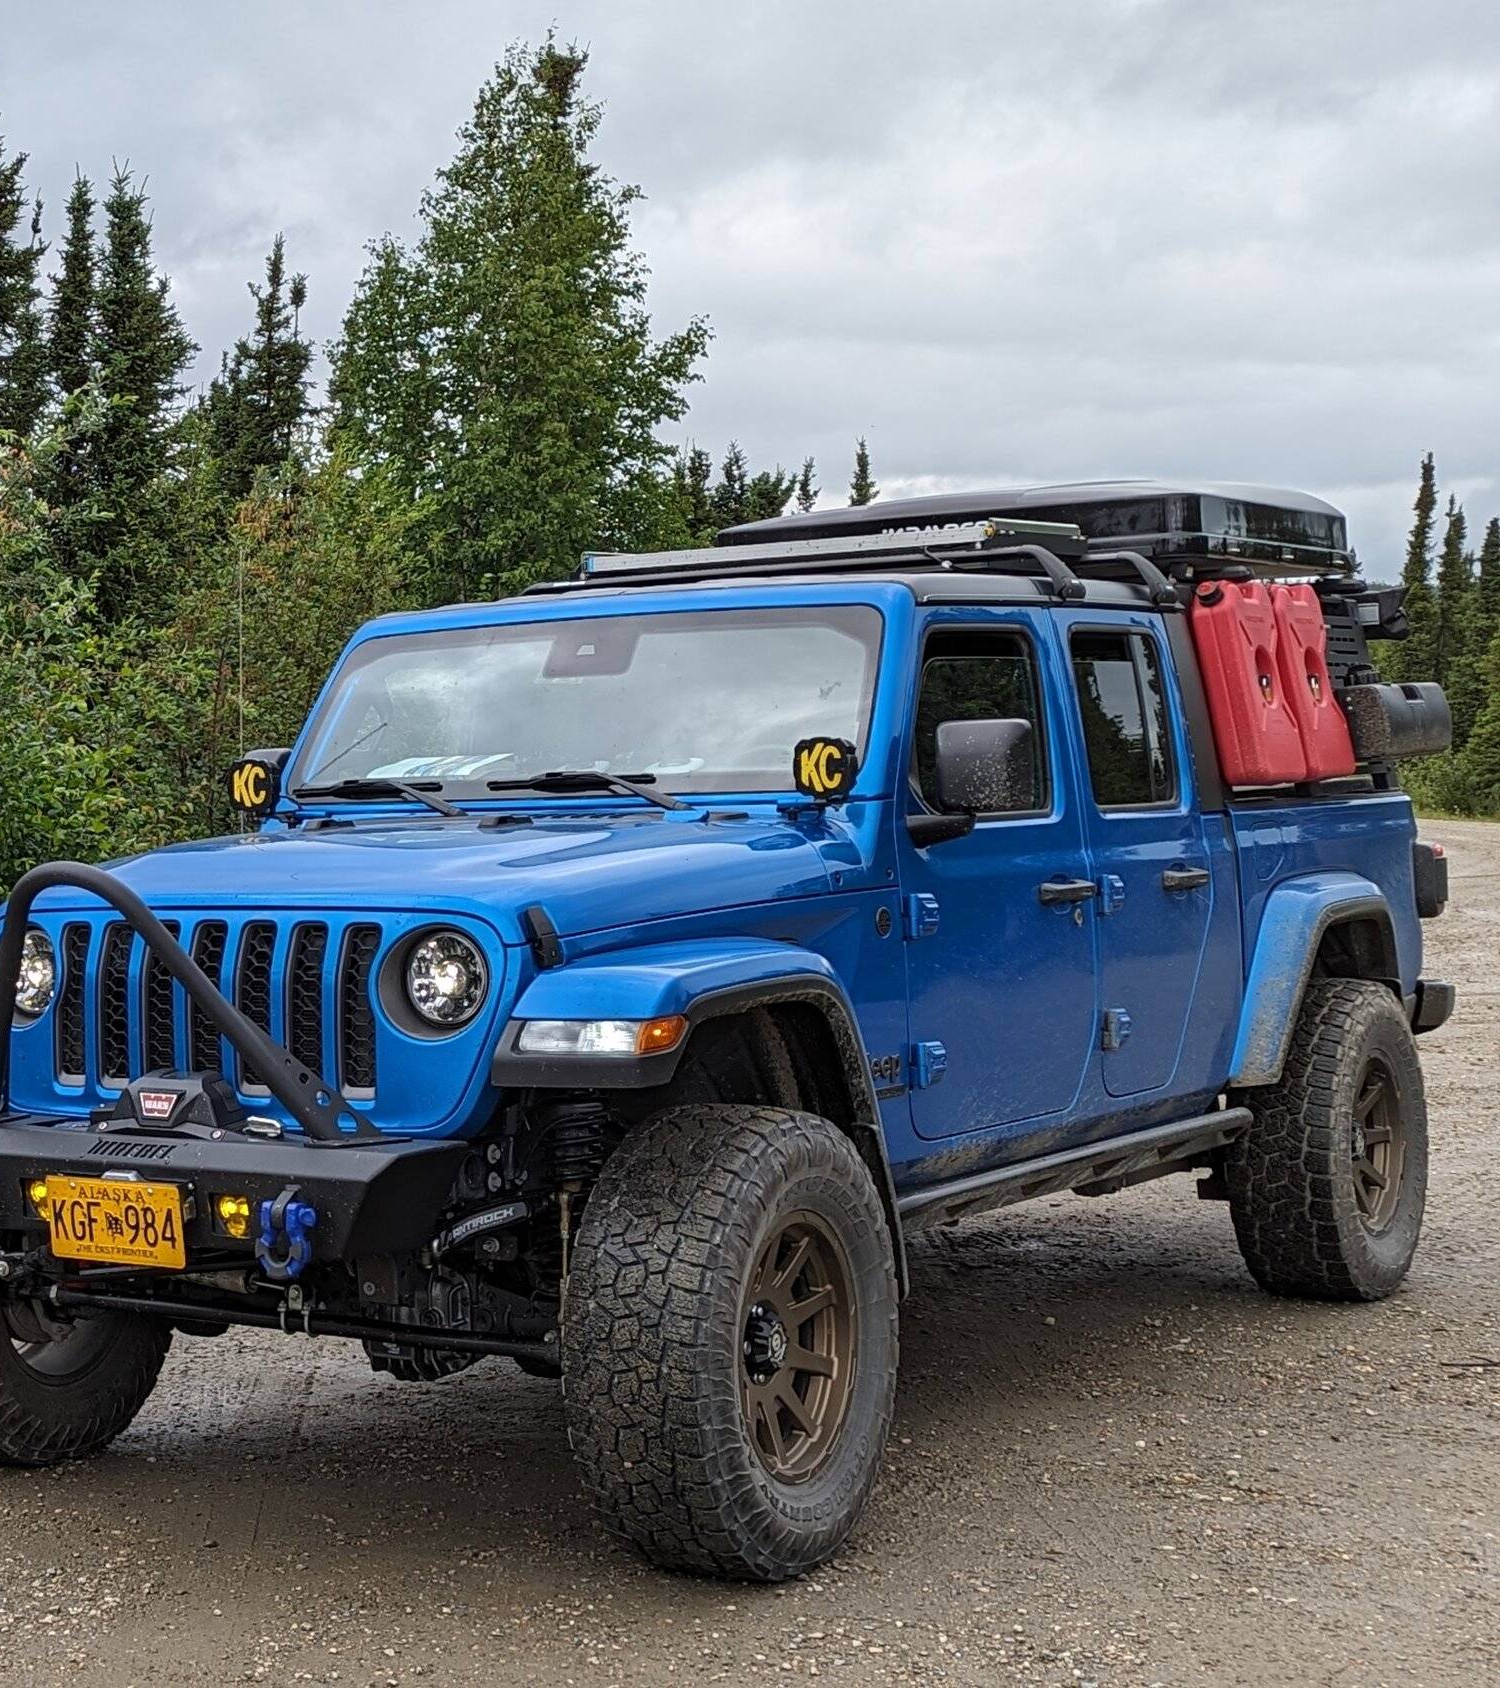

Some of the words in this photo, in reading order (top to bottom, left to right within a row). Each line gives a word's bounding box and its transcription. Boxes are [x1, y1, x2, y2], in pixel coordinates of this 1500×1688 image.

[234, 764, 266, 807] KC
[801, 742, 842, 792] KC
[867, 1052, 900, 1083] eep
[78, 1186, 146, 1204] ALASKA
[52, 1199, 101, 1242] KGF
[124, 1205, 177, 1249] 984
